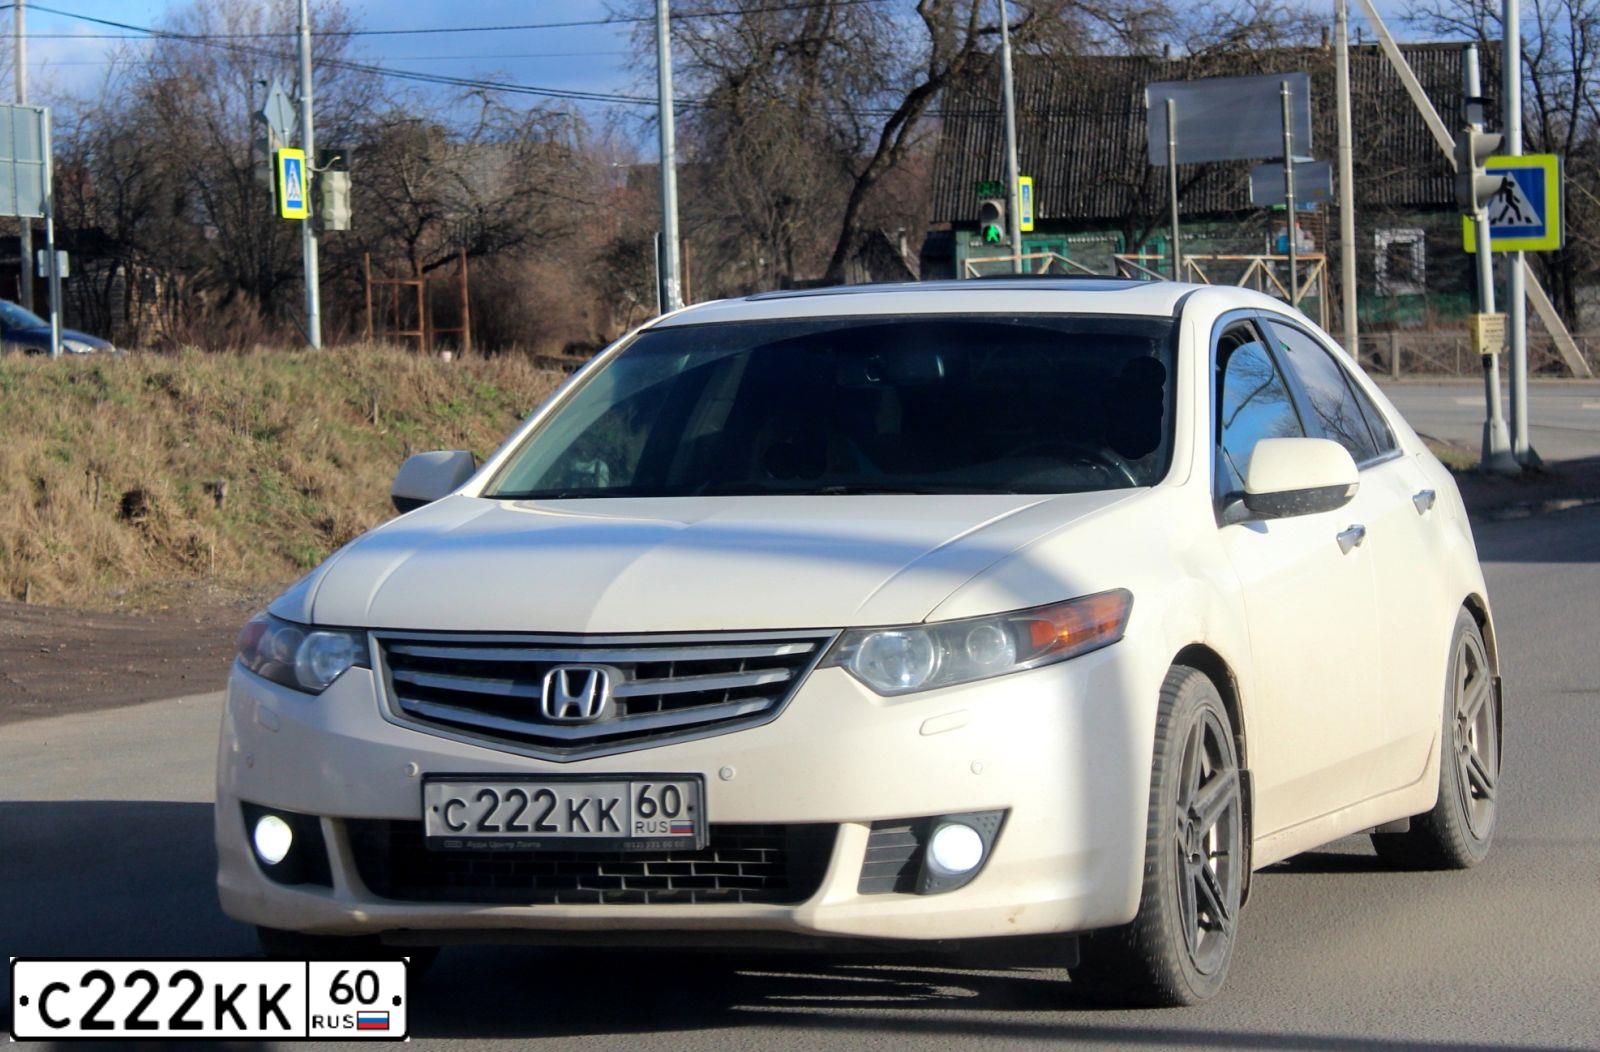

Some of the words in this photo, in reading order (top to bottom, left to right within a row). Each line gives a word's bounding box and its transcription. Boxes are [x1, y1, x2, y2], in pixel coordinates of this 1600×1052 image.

[443, 788, 620, 834] C222KK
[637, 784, 681, 819] 60
[635, 820, 669, 834] RUS
